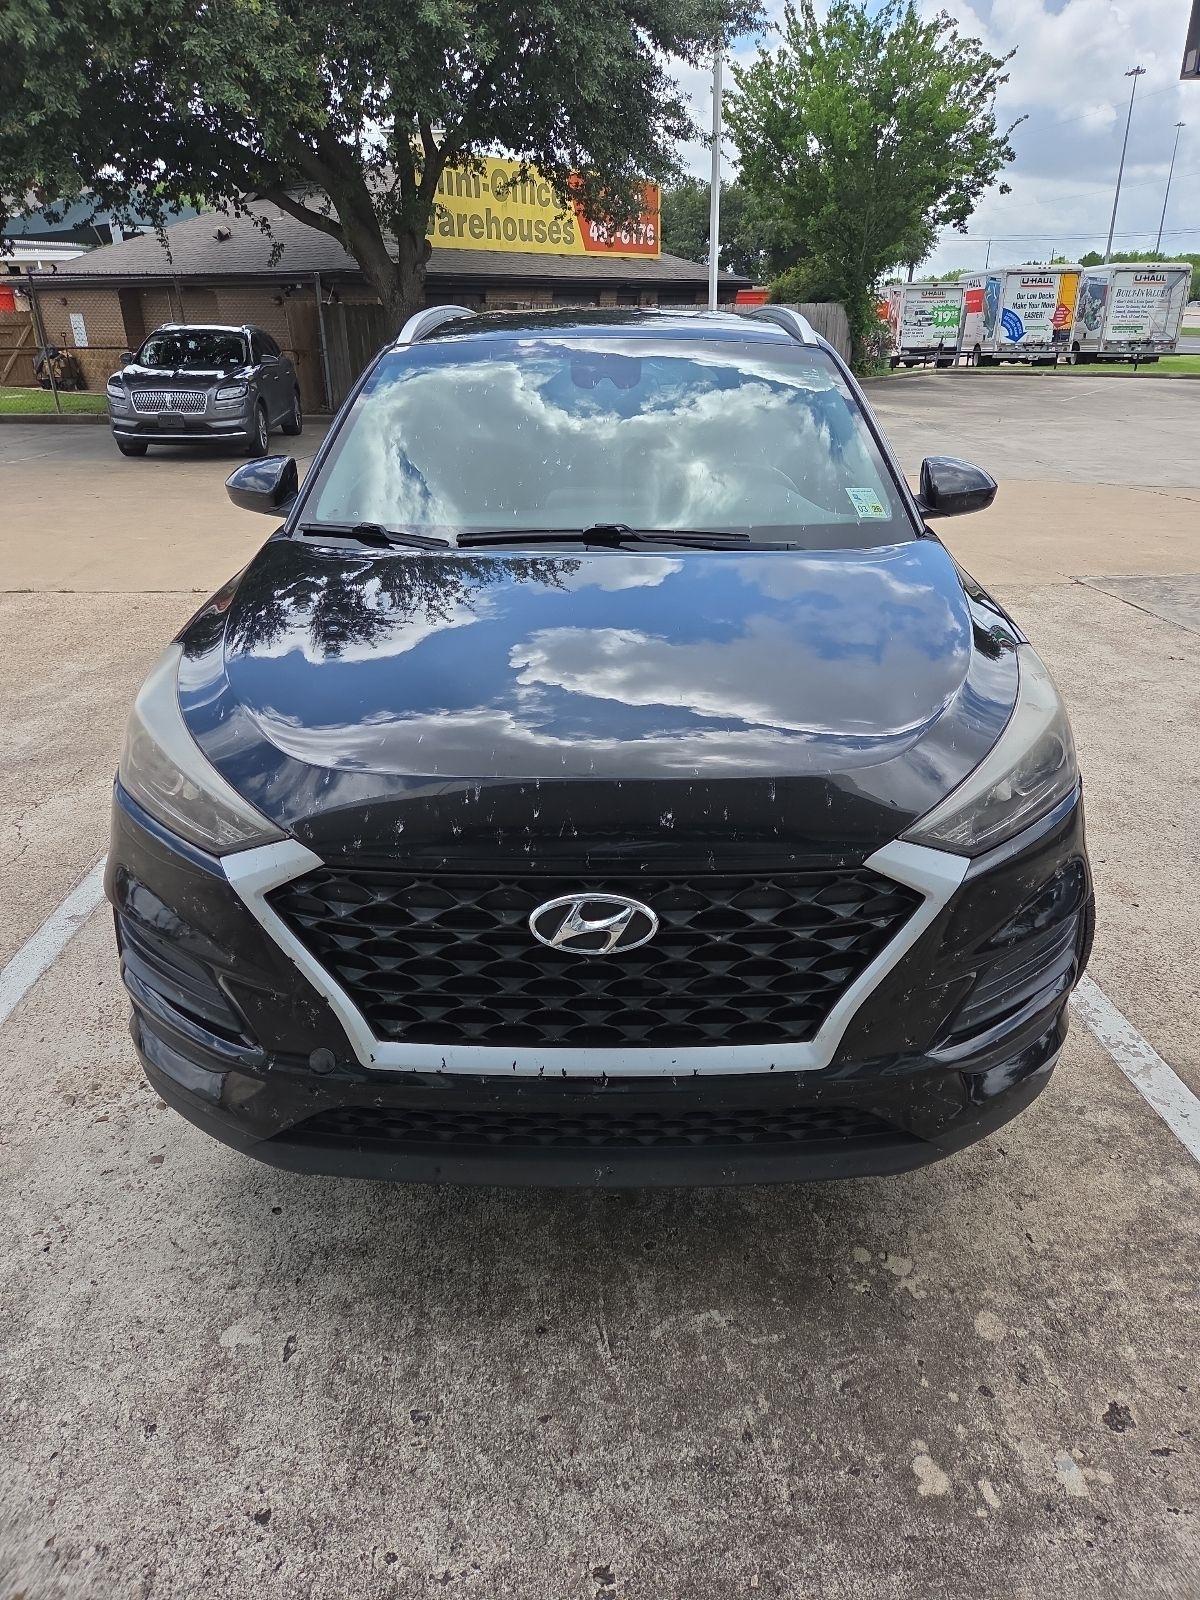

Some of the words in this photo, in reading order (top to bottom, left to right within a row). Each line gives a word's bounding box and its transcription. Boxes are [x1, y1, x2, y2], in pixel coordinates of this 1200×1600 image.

[1021, 277, 1054, 285] U-HAUL
[1134, 274, 1167, 282] U-HAUL
[1016, 292, 1026, 300] Our
[1027, 292, 1037, 300] Low
[1038, 292, 1055, 300] Decks
[1024, 311, 1046, 319] EASIER!
